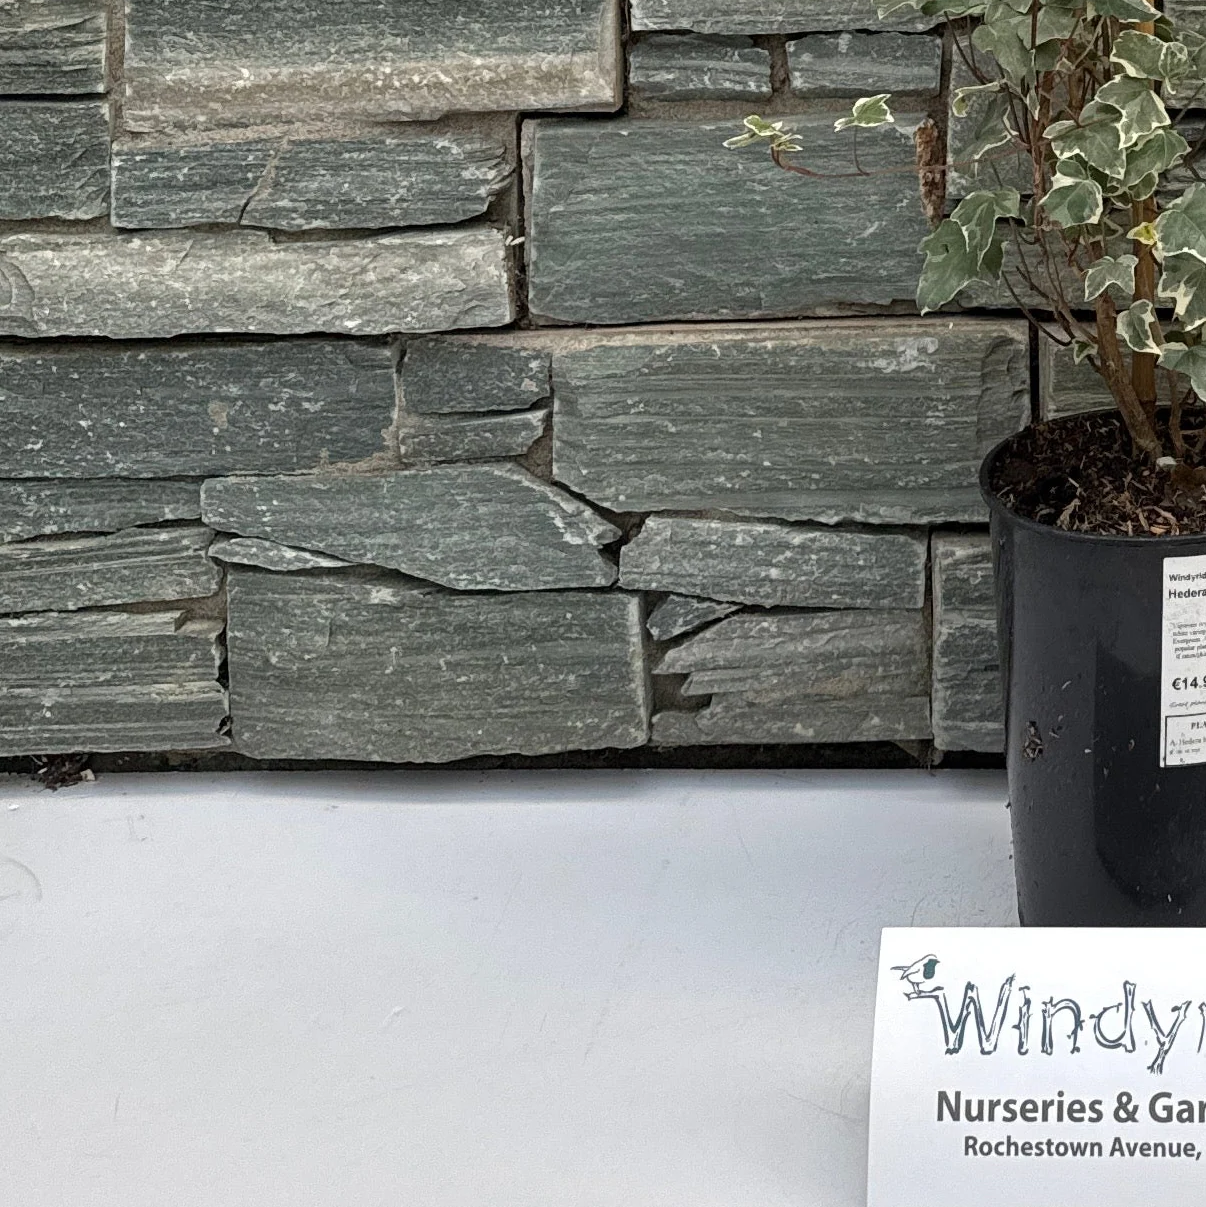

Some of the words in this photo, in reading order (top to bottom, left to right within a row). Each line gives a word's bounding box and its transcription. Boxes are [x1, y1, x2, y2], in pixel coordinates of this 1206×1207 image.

[936, 1090, 1104, 1124] Nurseries
[1113, 1091, 1139, 1125] &
[964, 1135, 1103, 1158] Rochestown
[1109, 1136, 1202, 1162] Avenue,
